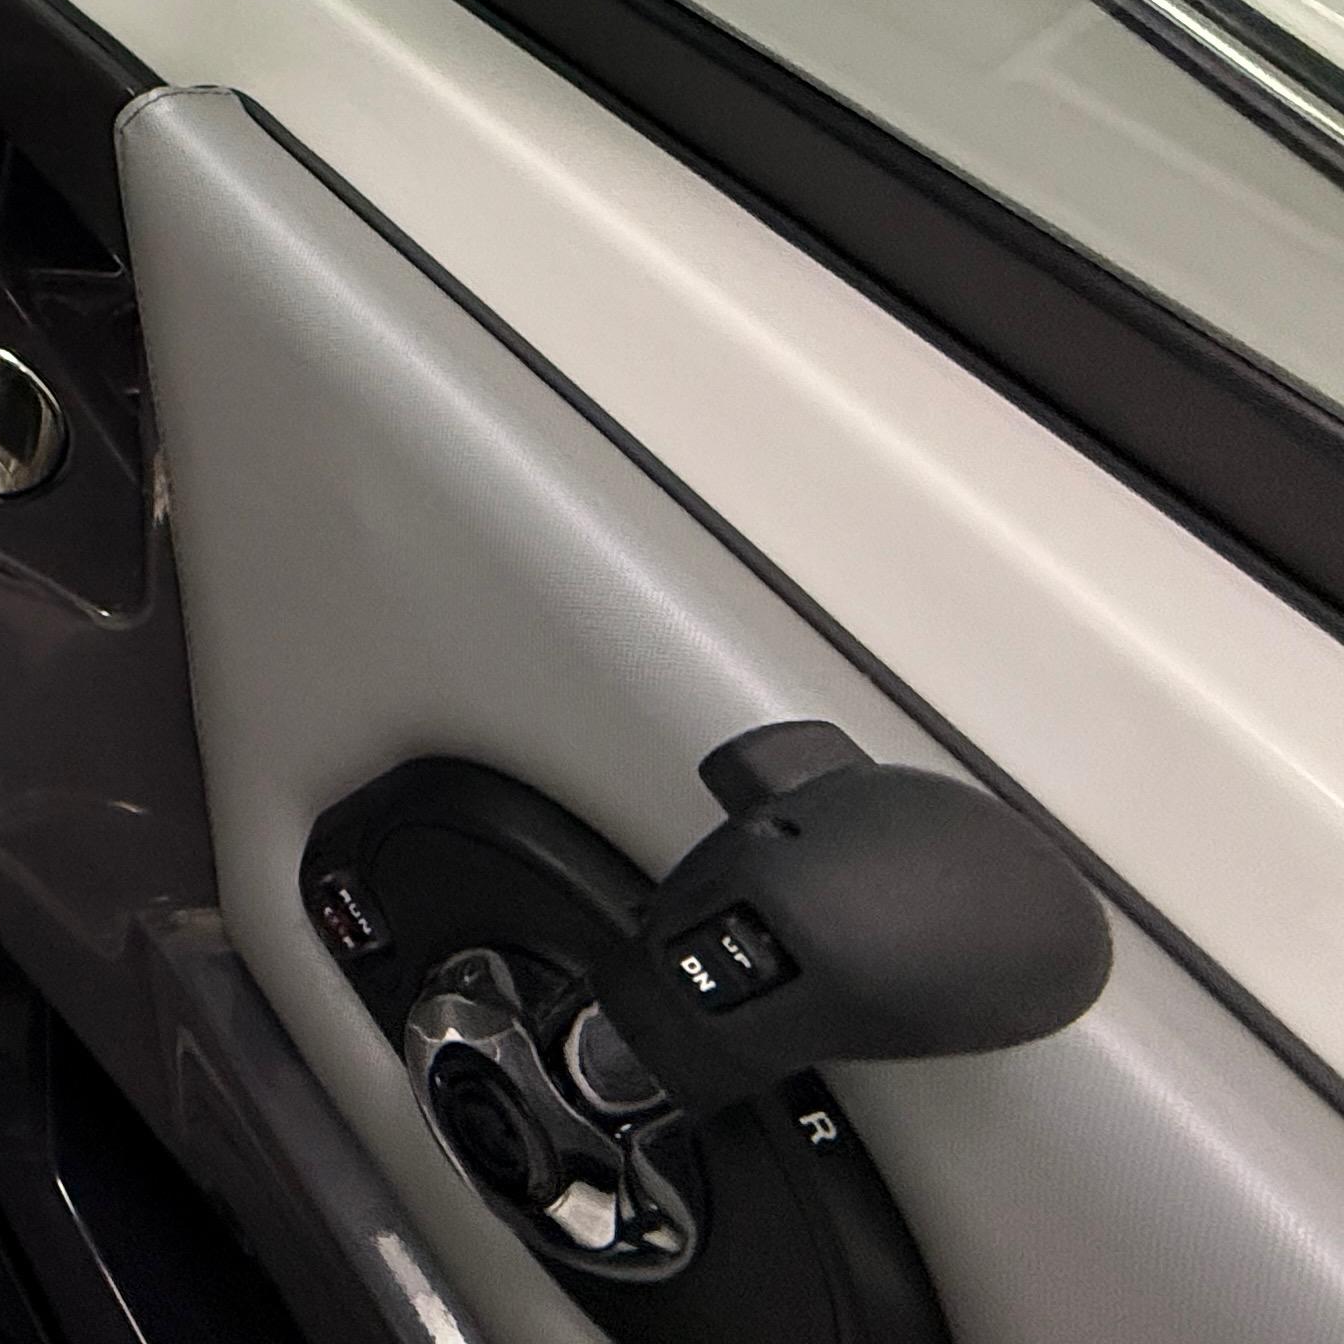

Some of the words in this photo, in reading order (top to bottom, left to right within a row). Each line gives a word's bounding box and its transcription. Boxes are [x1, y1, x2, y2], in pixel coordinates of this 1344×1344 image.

[339, 888, 372, 935] RUN
[722, 935, 752, 969] UP
[680, 955, 717, 993] DN
[798, 1110, 838, 1145] R
